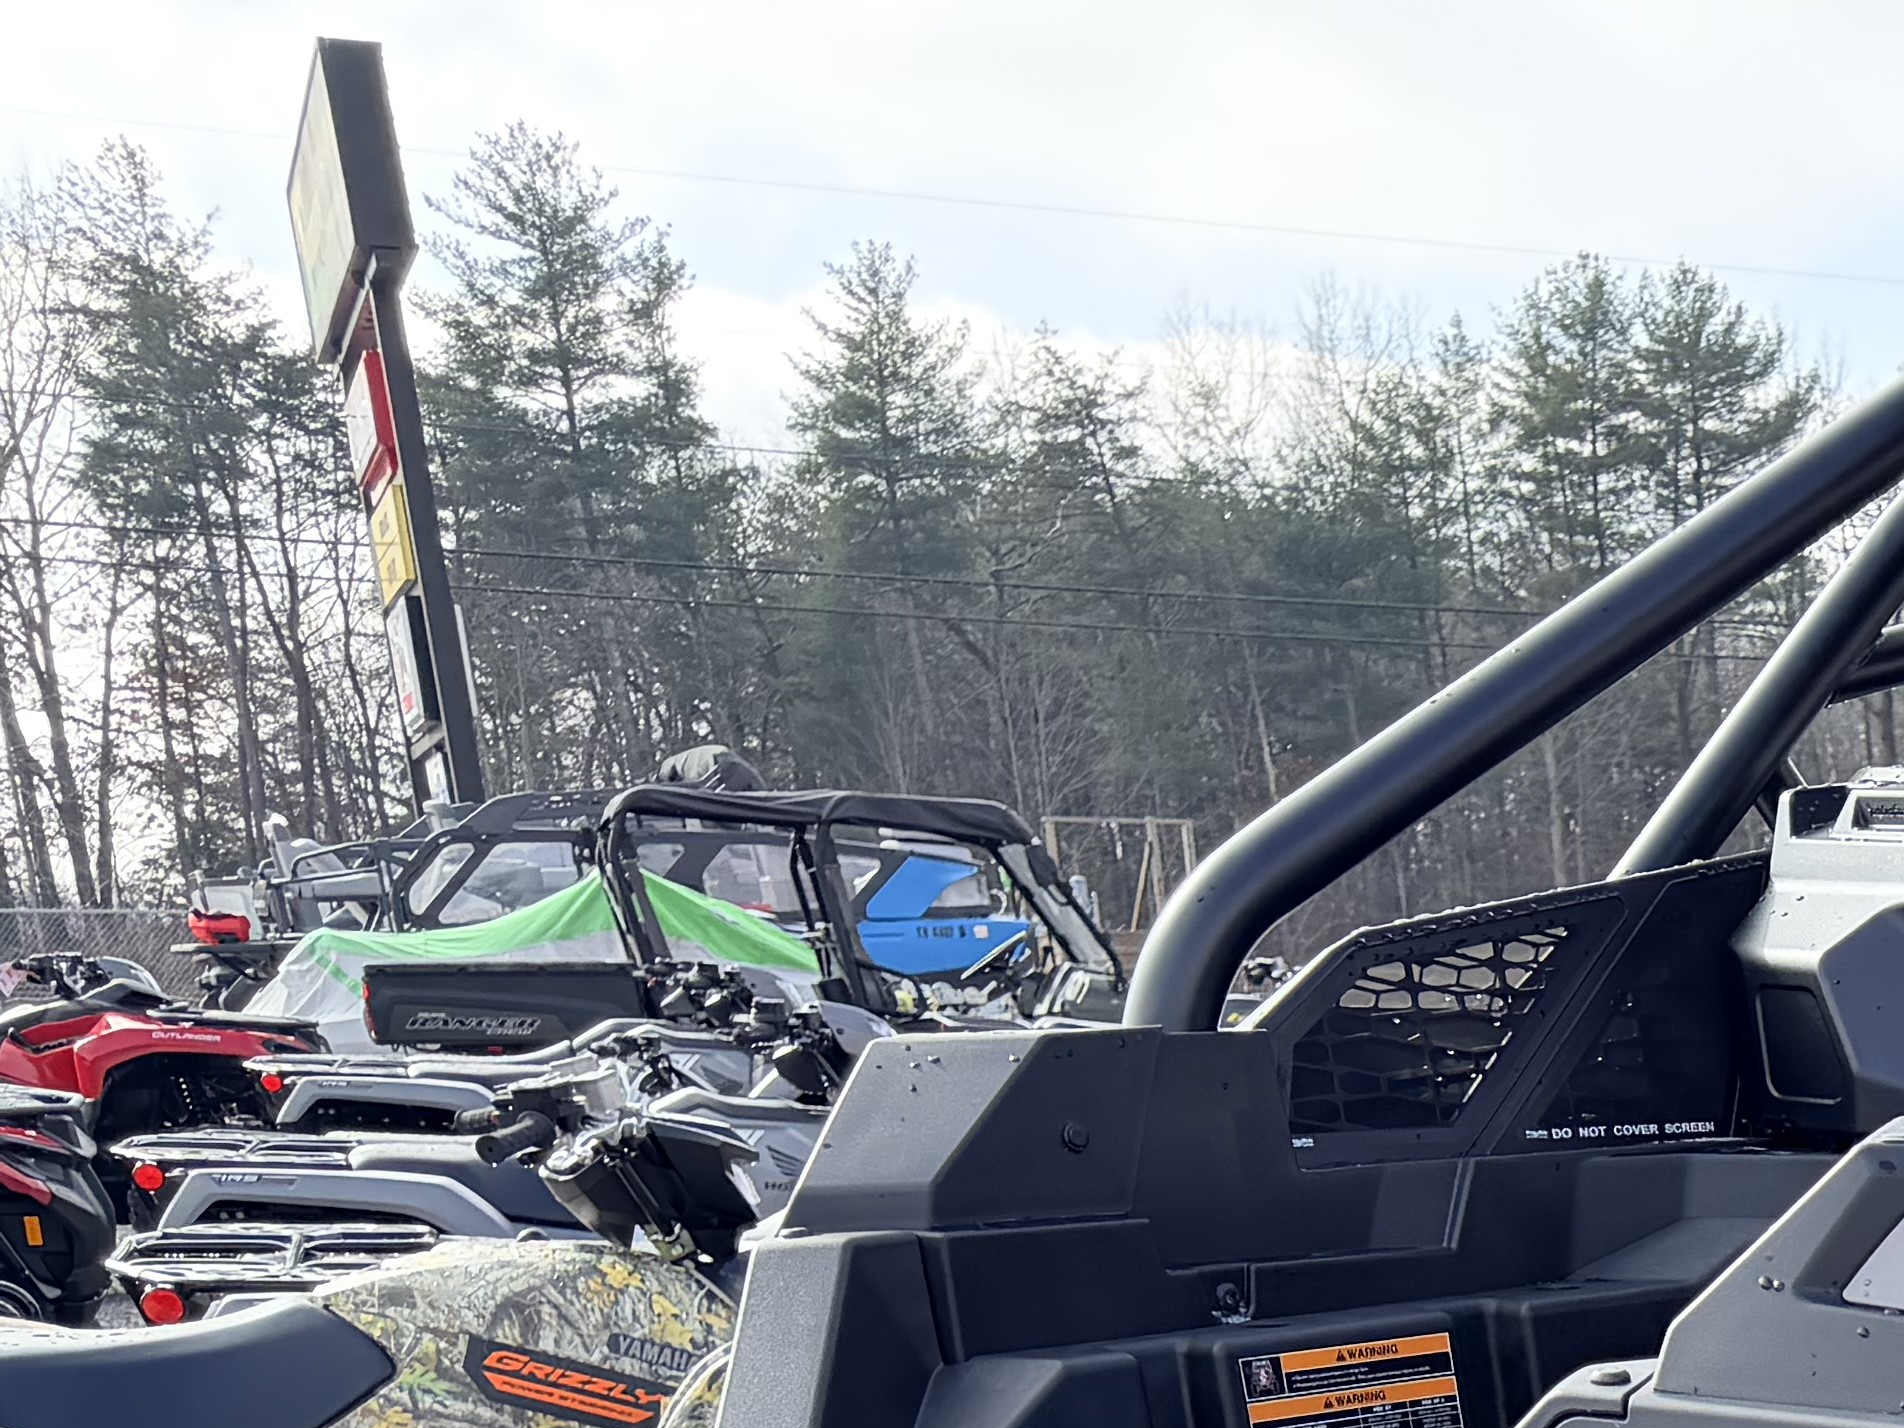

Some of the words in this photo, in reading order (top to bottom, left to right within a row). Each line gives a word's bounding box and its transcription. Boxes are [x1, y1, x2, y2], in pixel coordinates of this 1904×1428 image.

[1552, 1128, 1572, 1139] DO
[1579, 1126, 1607, 1137] NOT
[1614, 1124, 1659, 1136] COVER
[1665, 1122, 1715, 1134] SCREEN
[1347, 1343, 1399, 1361] WARNING
[482, 1350, 670, 1404] GRIZZLY
[1335, 1389, 1387, 1408] WARNING
